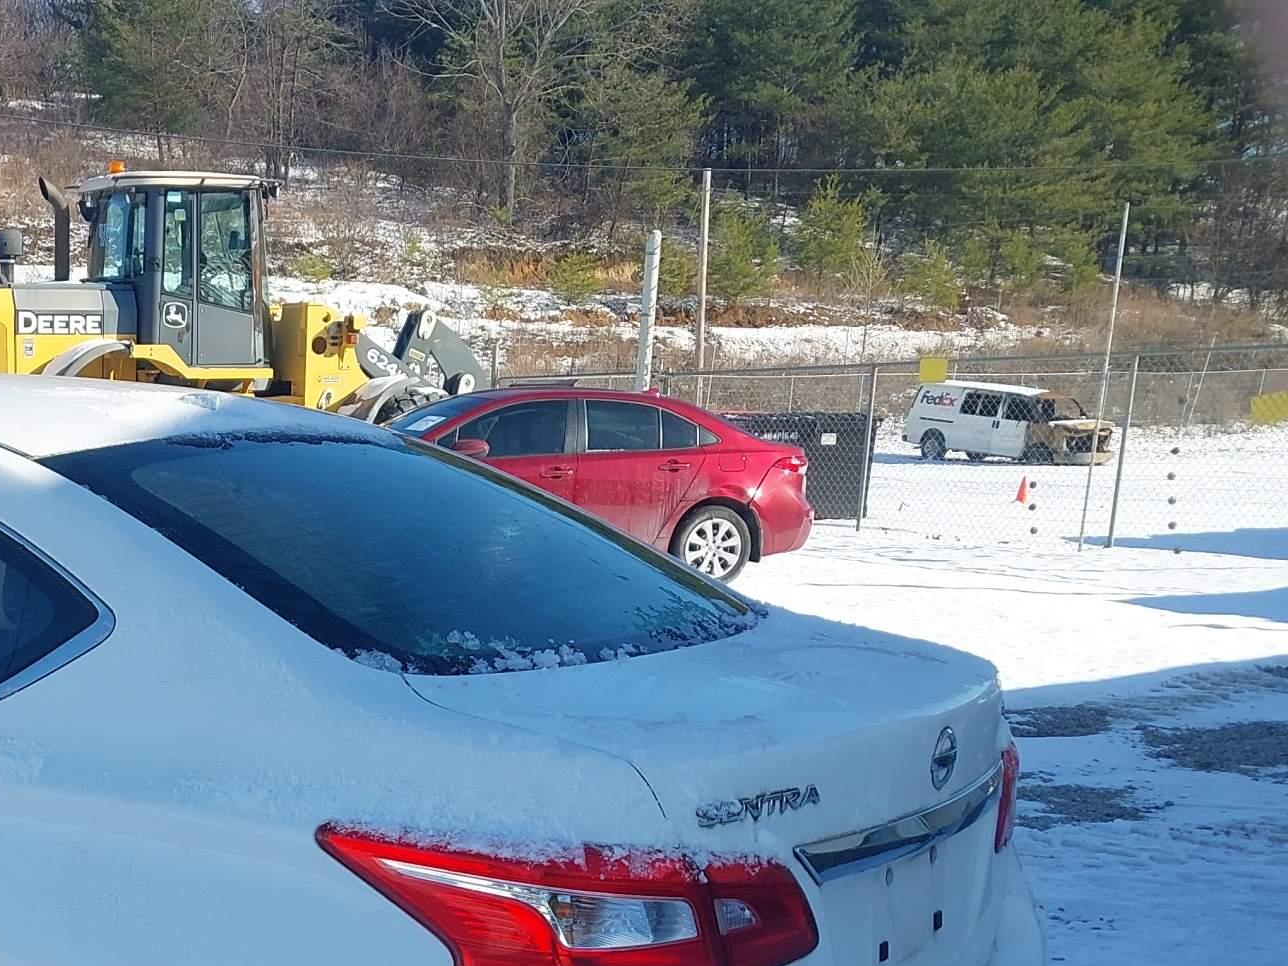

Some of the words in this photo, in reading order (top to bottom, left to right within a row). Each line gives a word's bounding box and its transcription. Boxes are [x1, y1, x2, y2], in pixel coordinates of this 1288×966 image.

[17, 309, 102, 334] DEERE
[920, 390, 958, 407] FedEx
[696, 784, 821, 829] SENTRA
